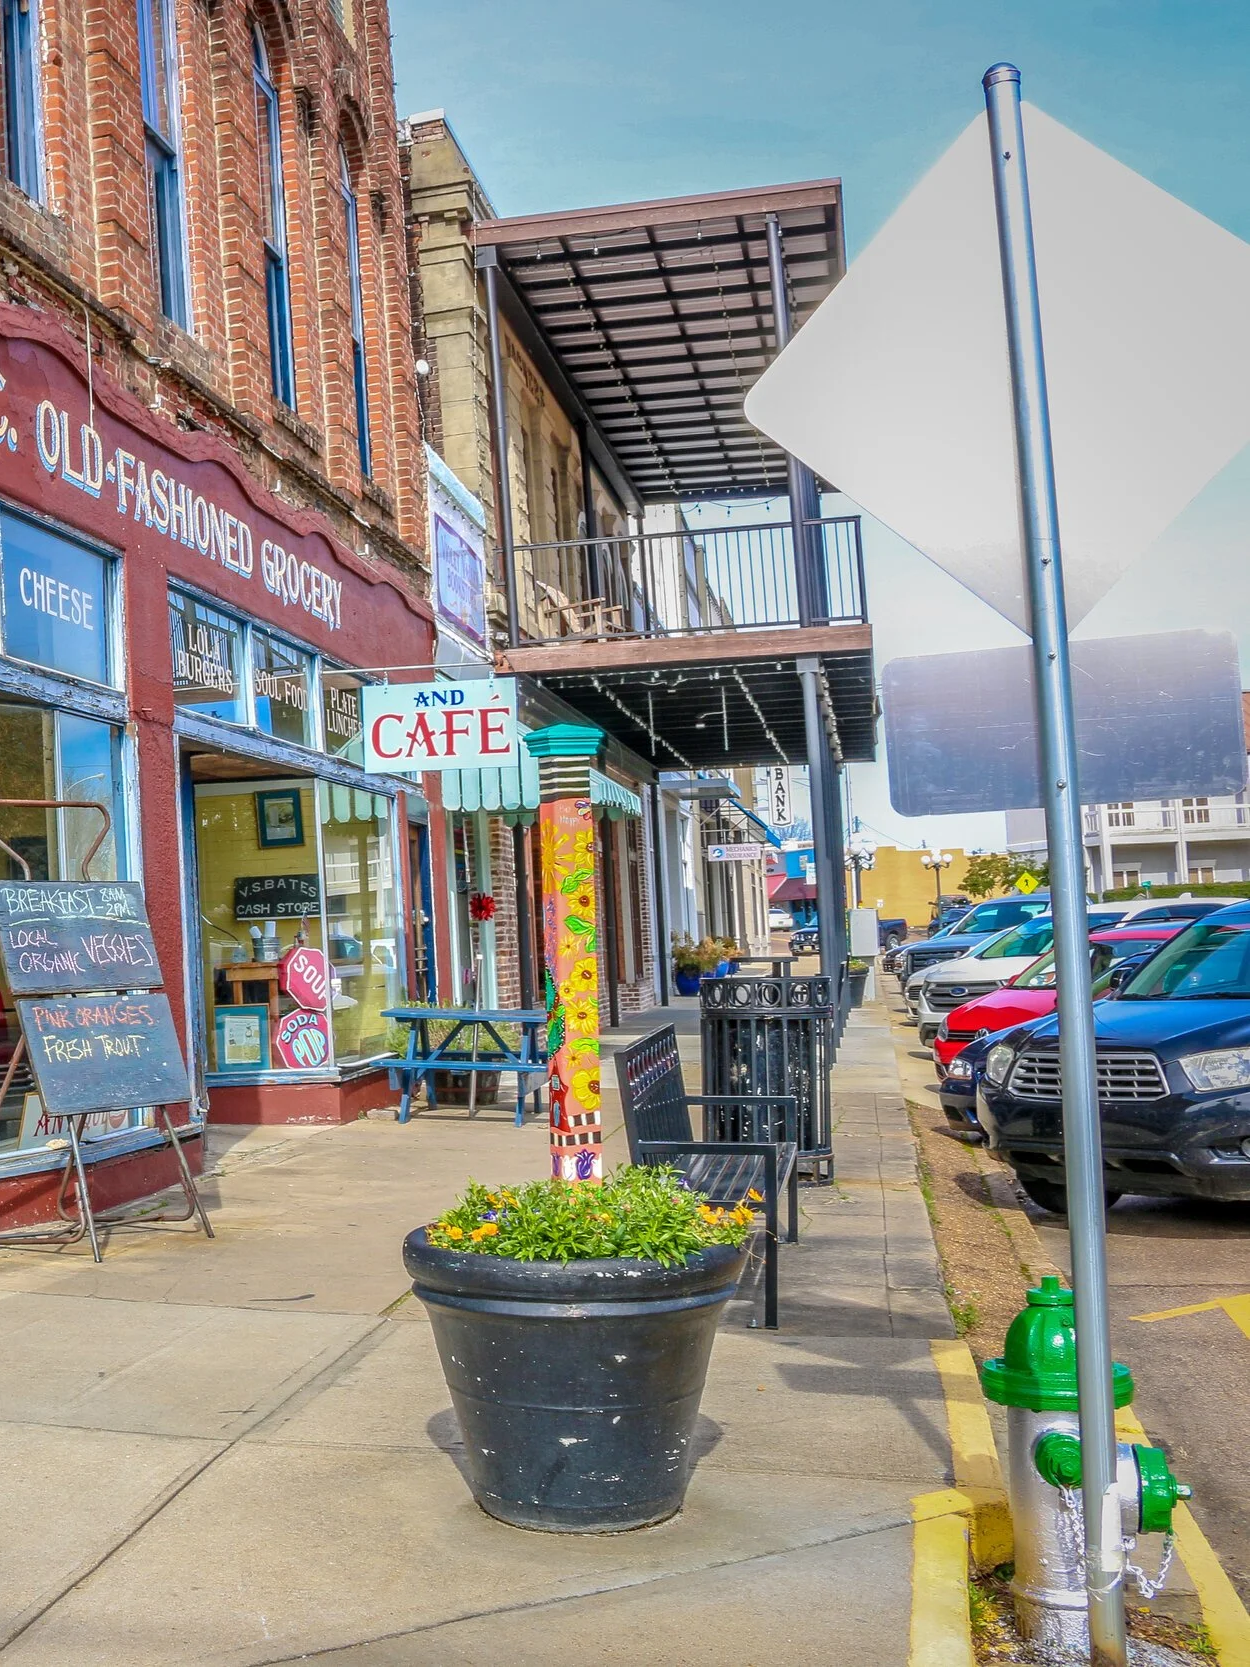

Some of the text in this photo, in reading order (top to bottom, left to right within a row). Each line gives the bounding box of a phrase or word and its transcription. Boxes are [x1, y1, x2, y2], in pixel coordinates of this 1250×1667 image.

[20, 568, 94, 631] CHEESE
[261, 538, 342, 632] GROCERY
[187, 623, 220, 660] LOLA
[177, 650, 233, 694] BURGERS
[255, 668, 308, 712] SOUL FOOD
[330, 686, 357, 718] PLATE
[414, 690, 464, 707] AND
[372, 694, 510, 758] CAFÉ
[774, 767, 786, 821] BANK
[0, 888, 95, 916] BREAKFAST
[236, 901, 319, 915] CASH STORE
[9, 929, 58, 949] LOCAL
[19, 933, 153, 975] ORGANIC VEGGIES
[32, 1006, 74, 1032] PINK
[281, 1013, 318, 1043] SODA
[42, 1034, 93, 1063] FRESH
[292, 1028, 326, 1066] POP
